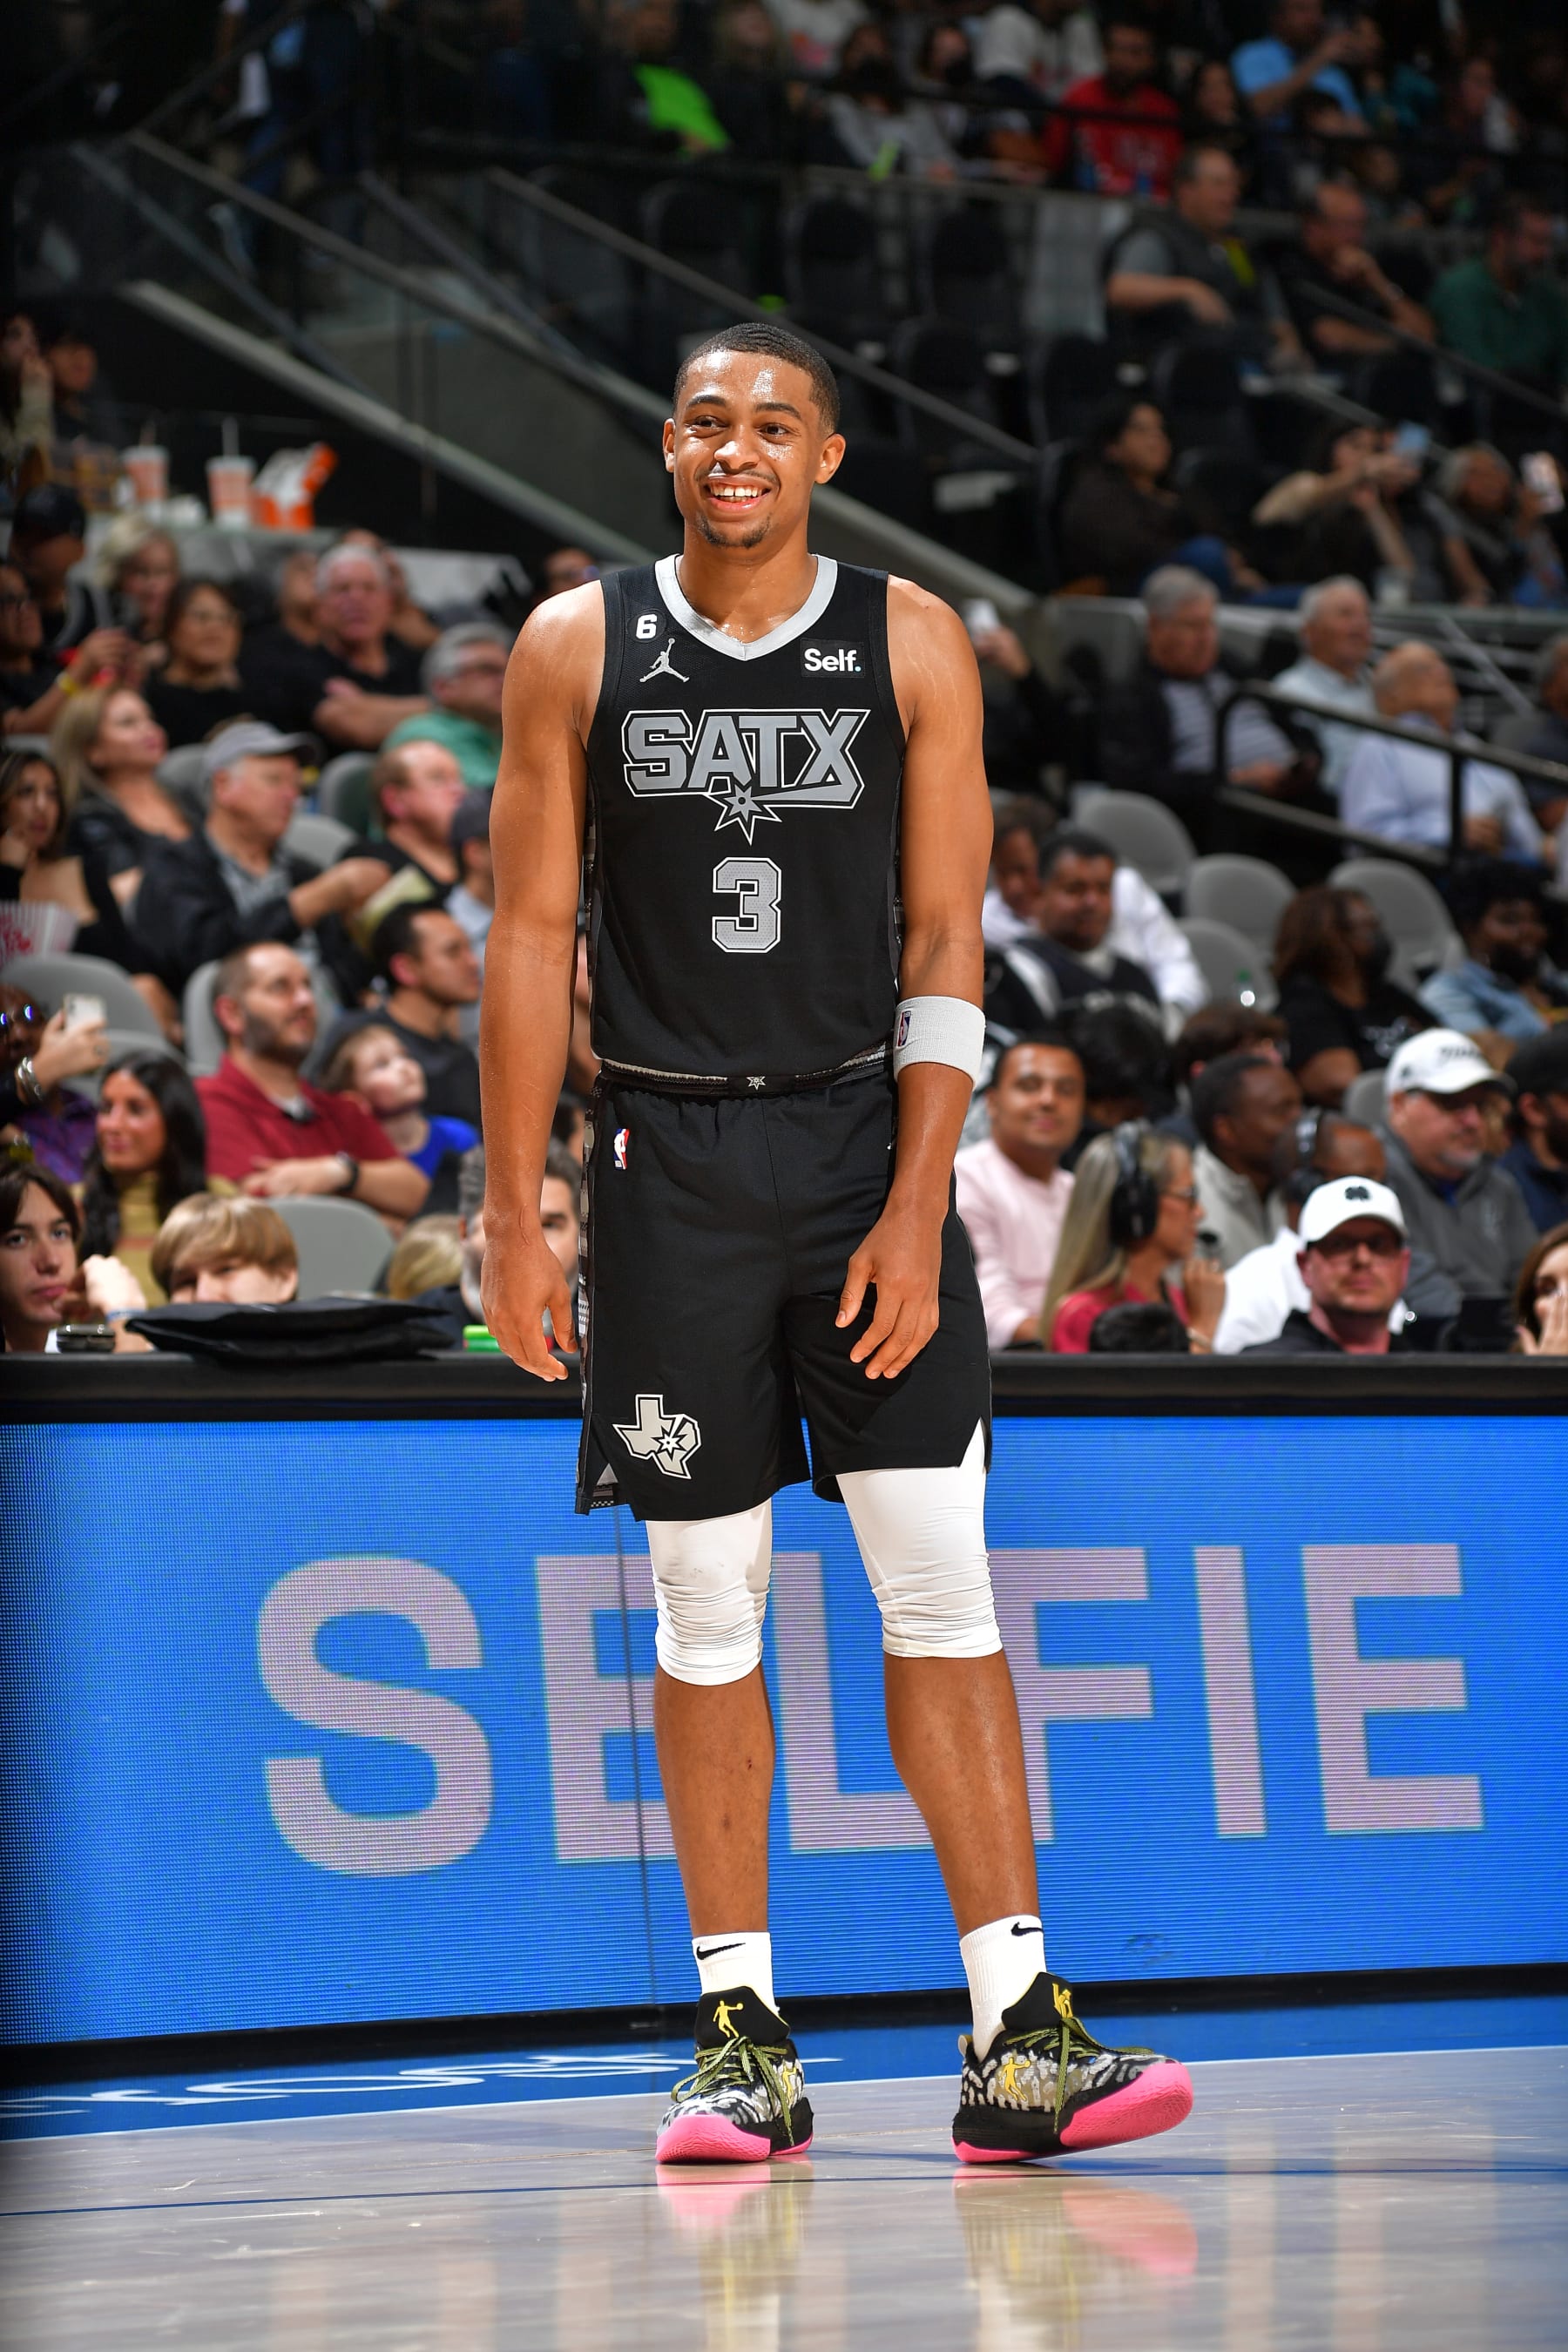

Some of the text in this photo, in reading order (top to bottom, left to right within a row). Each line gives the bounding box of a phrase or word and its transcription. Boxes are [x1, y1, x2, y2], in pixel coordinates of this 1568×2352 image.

[635, 613, 658, 640] 6
[803, 647, 862, 673] Self.
[622, 708, 871, 810] SATX
[712, 856, 782, 954] 3
[258, 1541, 1484, 1877] SELFIE
[0, 2053, 843, 2118] rost
